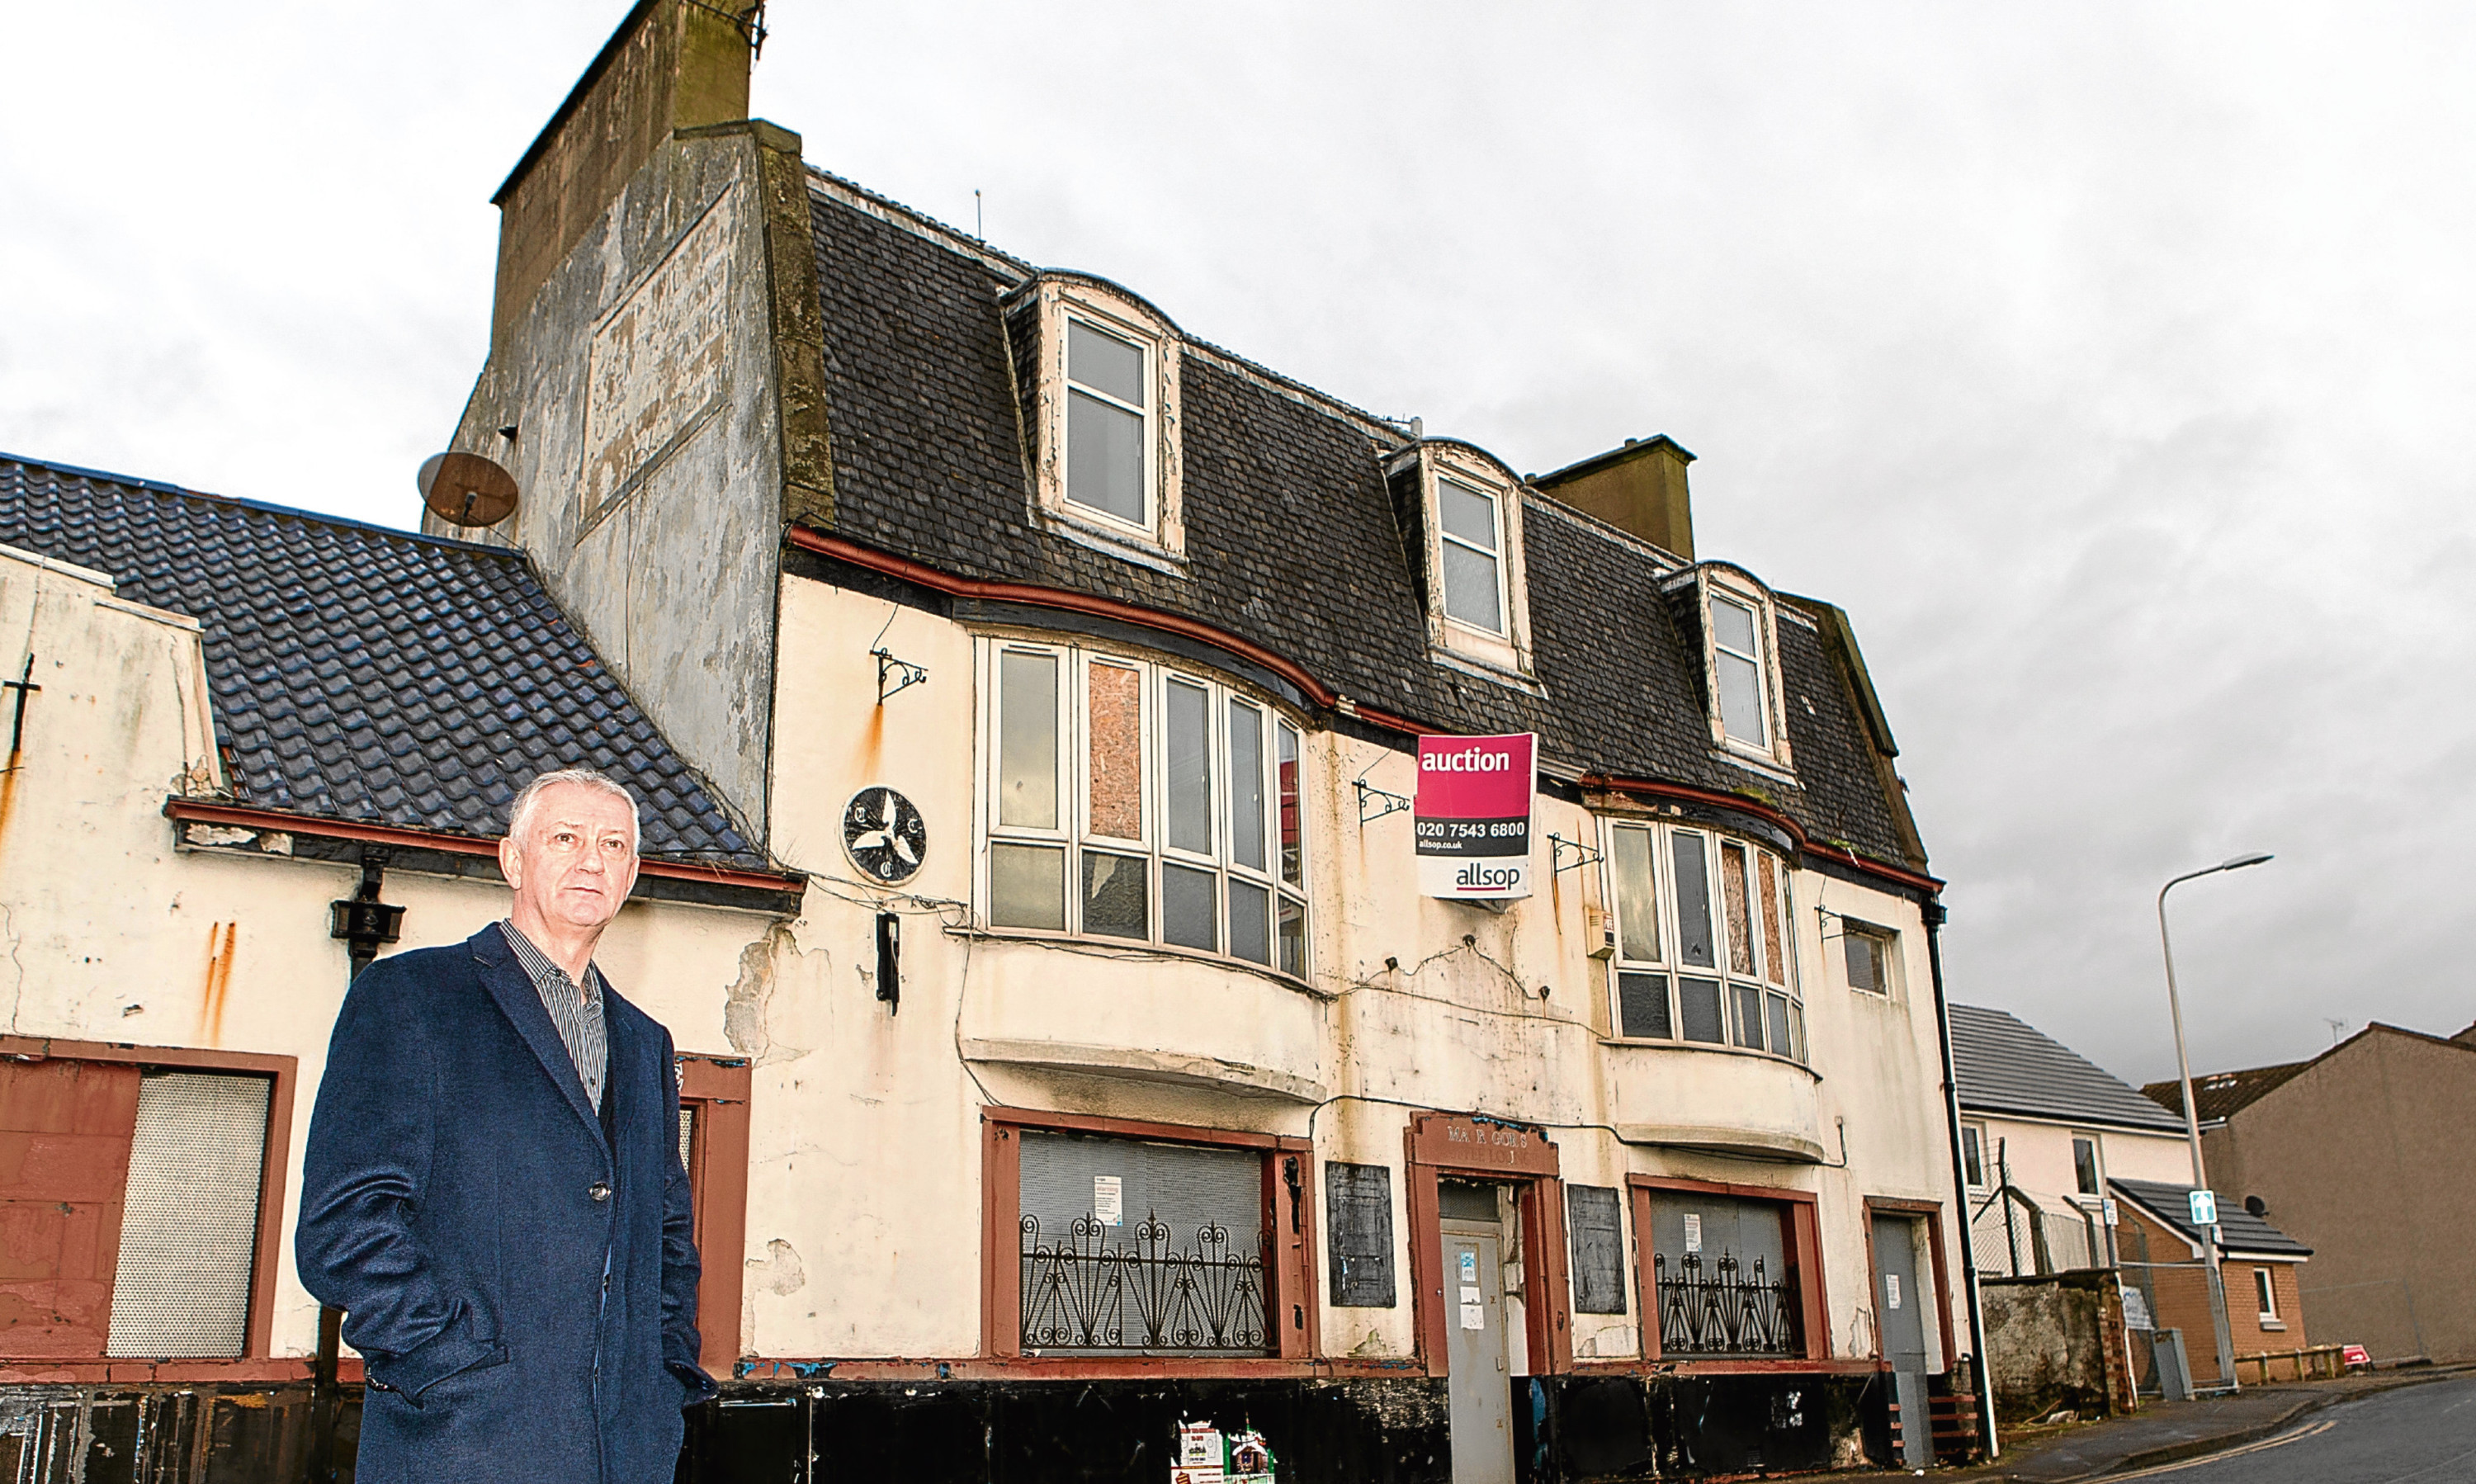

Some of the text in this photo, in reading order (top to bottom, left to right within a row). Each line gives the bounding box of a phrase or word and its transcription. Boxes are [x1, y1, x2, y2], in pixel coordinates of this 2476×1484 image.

[1421, 746, 1510, 772] auction
[1416, 821, 1525, 838] 020 7543 6800
[1419, 839, 1463, 851] allsop.co.uk
[1456, 863, 1520, 891] allsop
